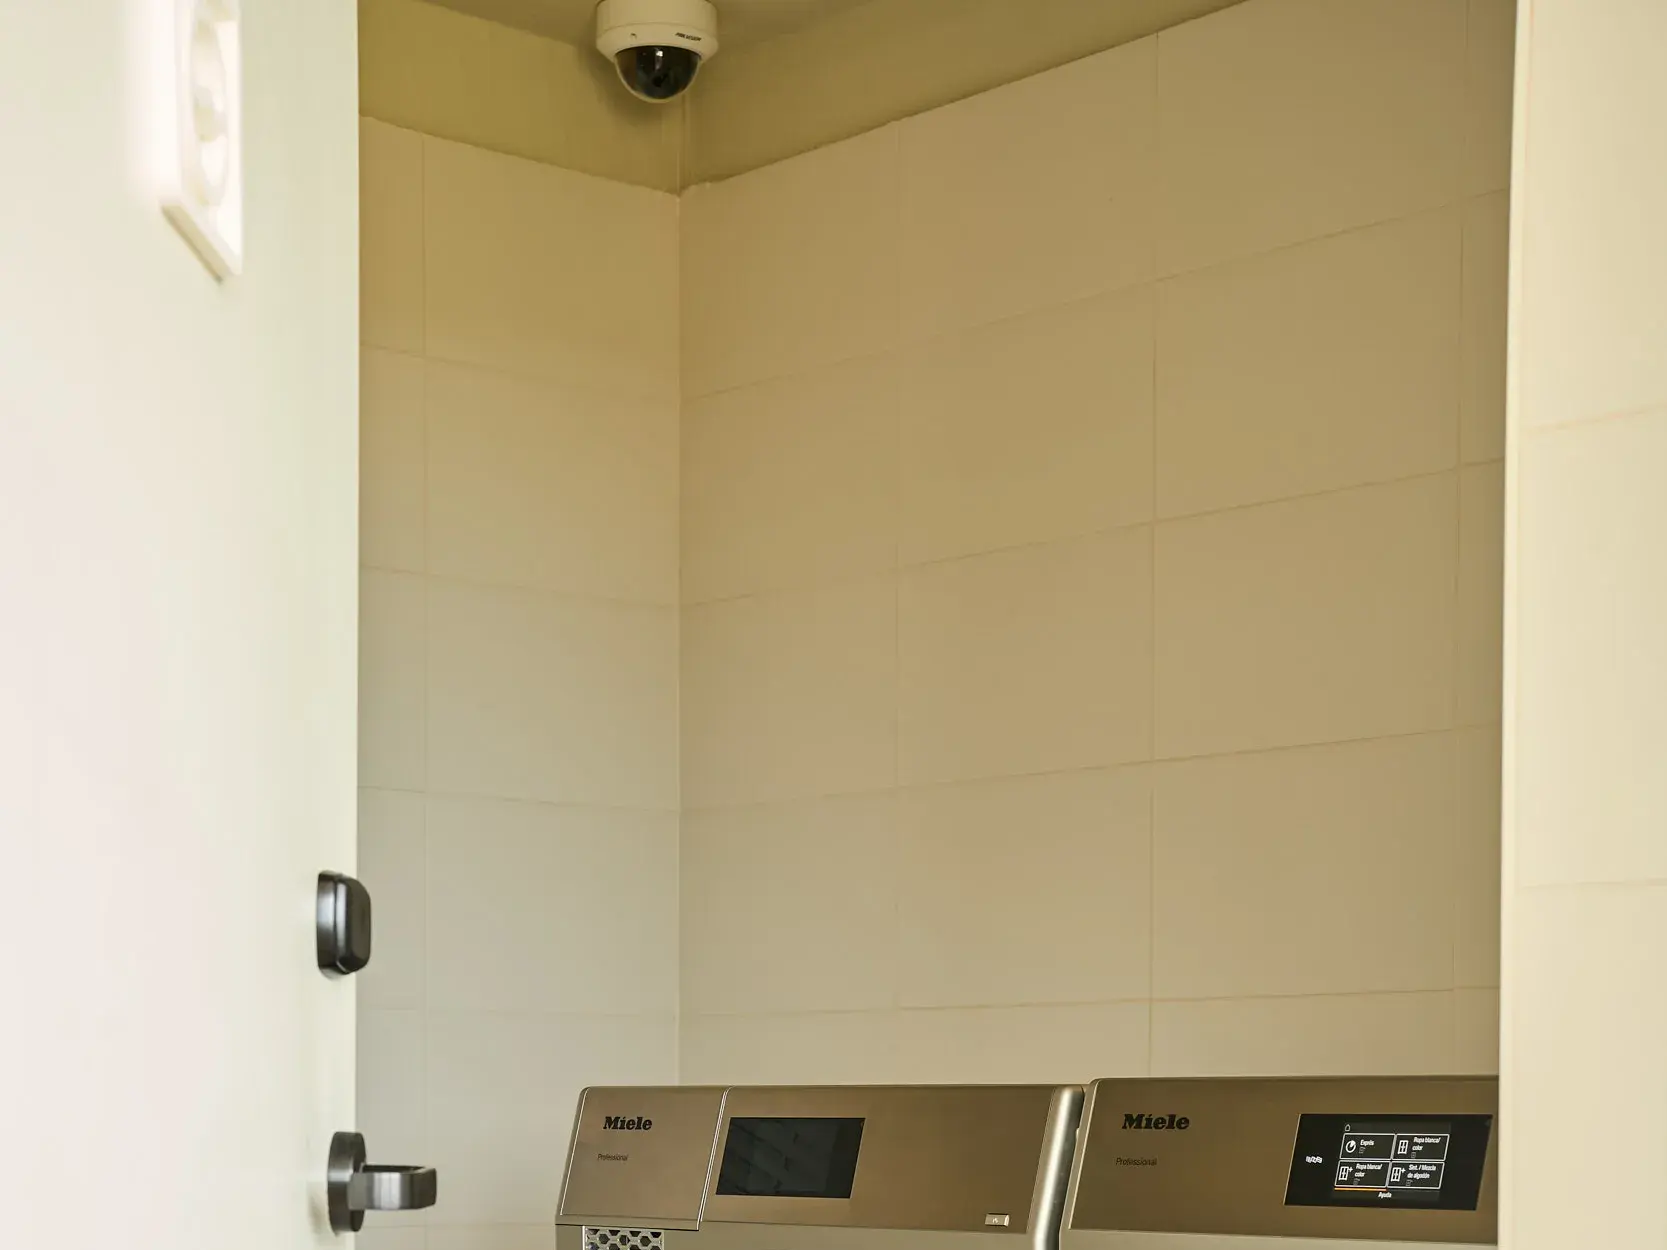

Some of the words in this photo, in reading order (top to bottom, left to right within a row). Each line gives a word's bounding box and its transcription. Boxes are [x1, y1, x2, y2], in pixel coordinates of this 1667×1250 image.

[602, 1116, 652, 1130] Miele
[1121, 1113, 1190, 1130] Miele
[597, 1153, 629, 1162] Professional
[1115, 1157, 1158, 1166] Professional
